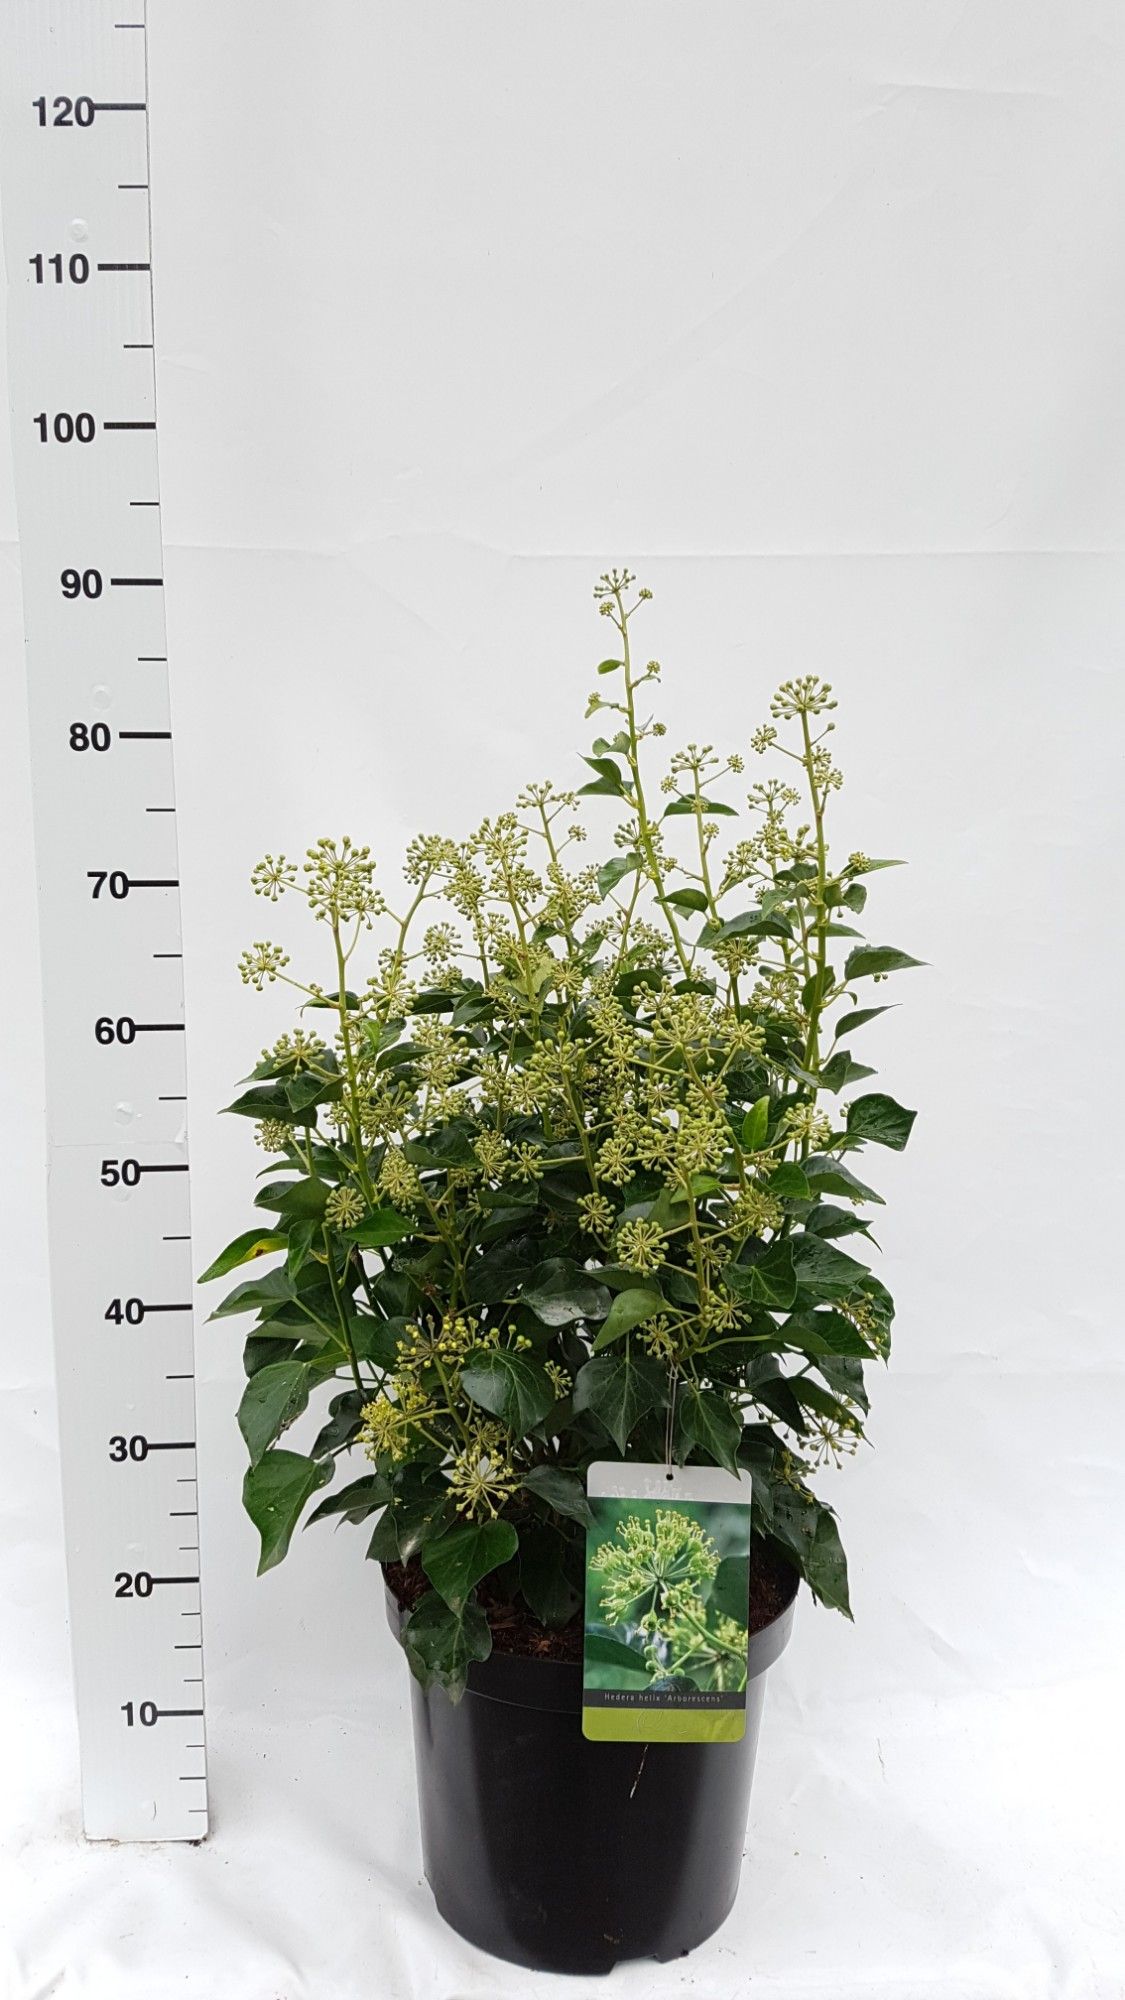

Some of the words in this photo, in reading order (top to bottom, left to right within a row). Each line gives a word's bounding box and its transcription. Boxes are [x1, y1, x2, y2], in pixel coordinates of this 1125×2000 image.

[32, 96, 95, 128] 120
[29, 253, 89, 284] 110
[33, 412, 96, 443] 100
[60, 568, 103, 599] 90
[69, 722, 111, 752] 80
[86, 870, 130, 900] 70
[94, 1016, 136, 1045] 60
[100, 1158, 141, 1187] 50
[104, 1297, 145, 1325] 40
[109, 1435, 149, 1463] 30
[114, 1571, 153, 1598] 20
[604, 1692, 634, 1702] Hedera
[638, 1693, 660, 1702] helix
[120, 1701, 158, 1727] 10
